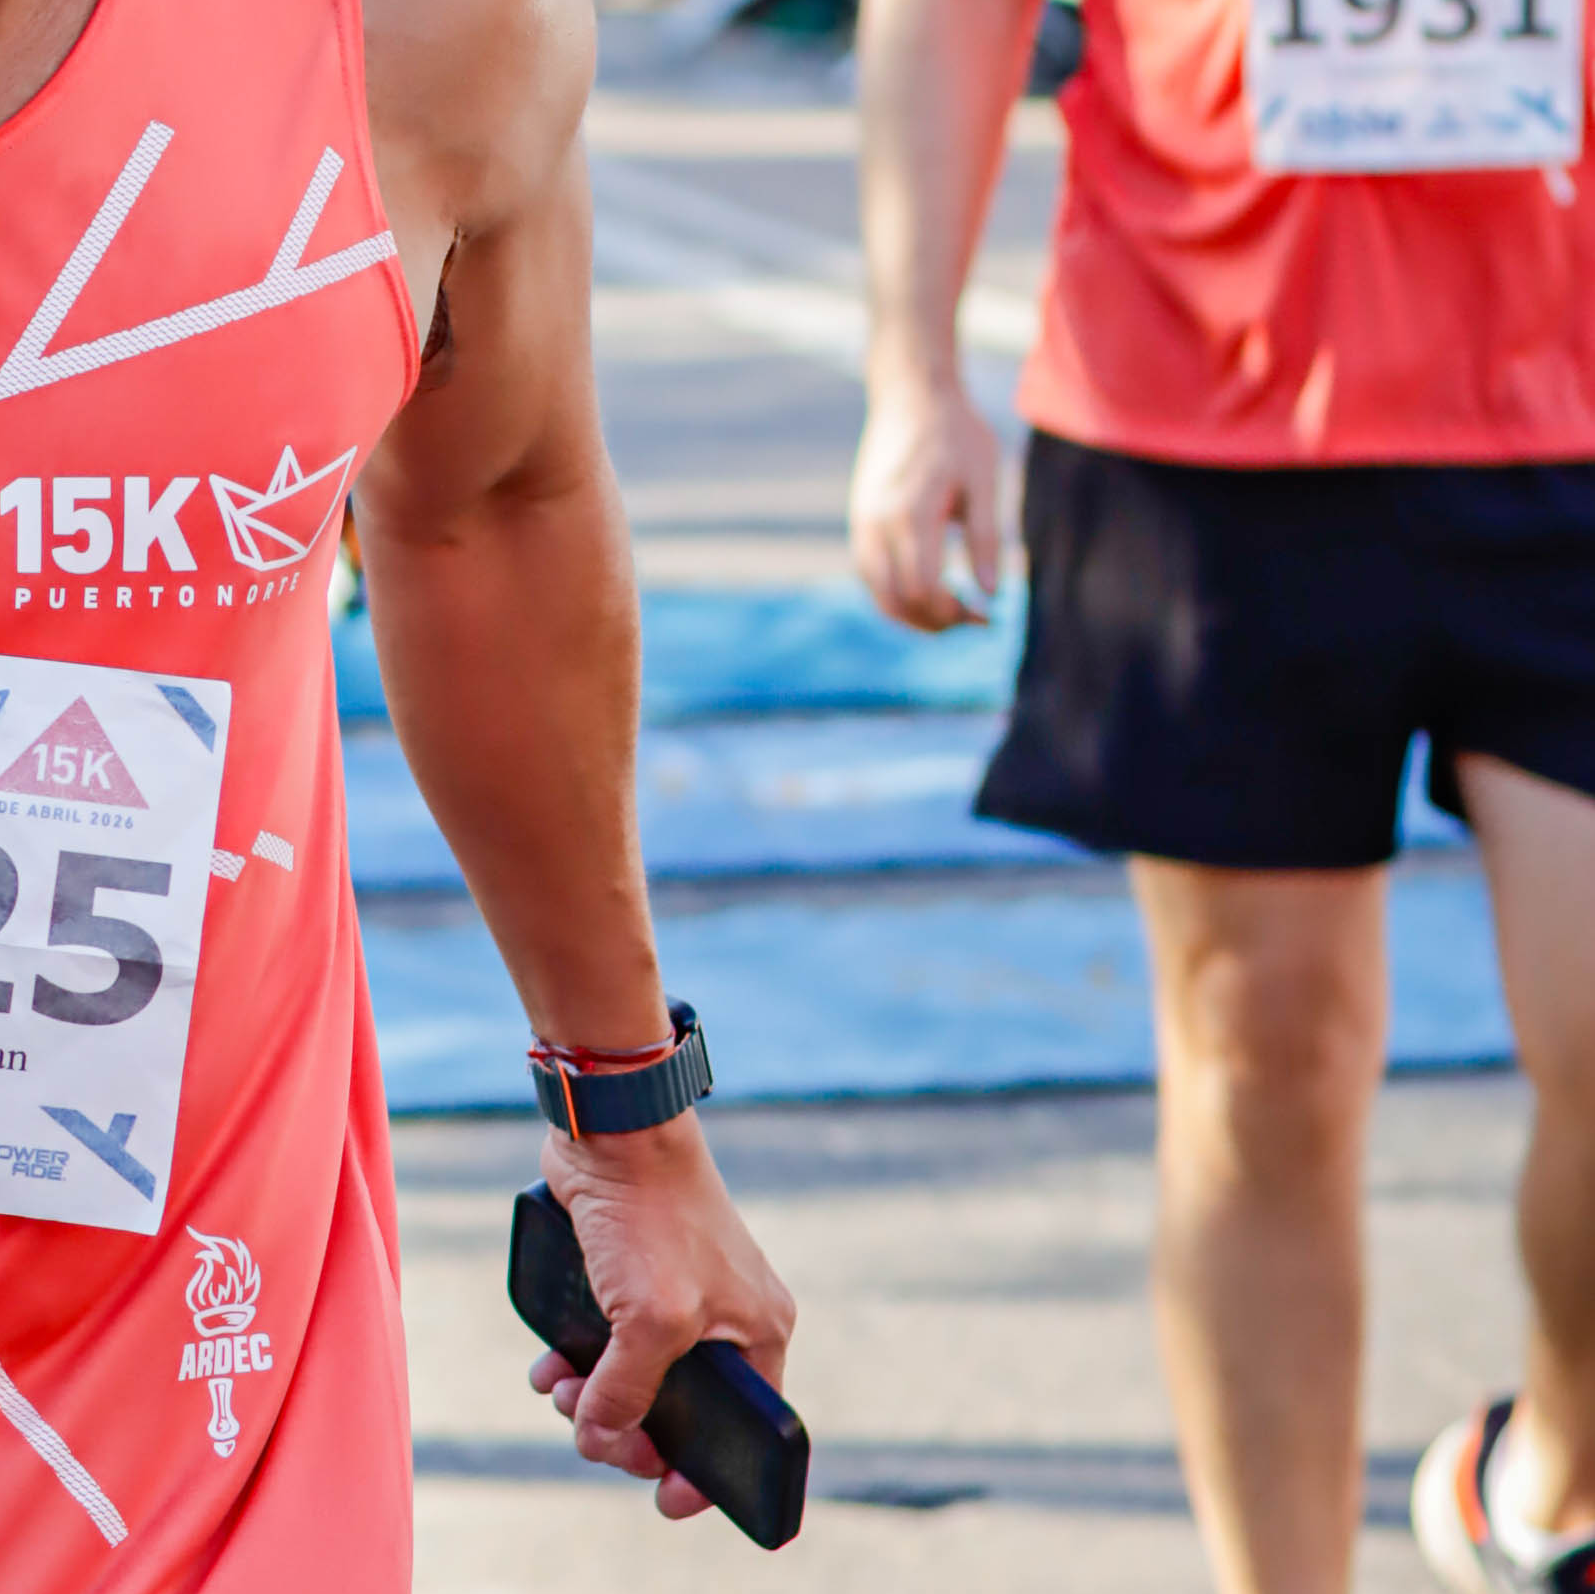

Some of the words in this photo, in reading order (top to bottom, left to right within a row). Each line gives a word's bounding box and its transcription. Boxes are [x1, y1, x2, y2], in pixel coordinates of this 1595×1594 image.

[0, 476, 200, 574] 15K
[15, 585, 195, 609] PUERTO
[217, 571, 301, 606] NORTE
[31, 742, 116, 790] 15K
[26, 804, 82, 824] ABRIL
[89, 811, 134, 830] 2026
[178, 1333, 273, 1381] ARDEC
